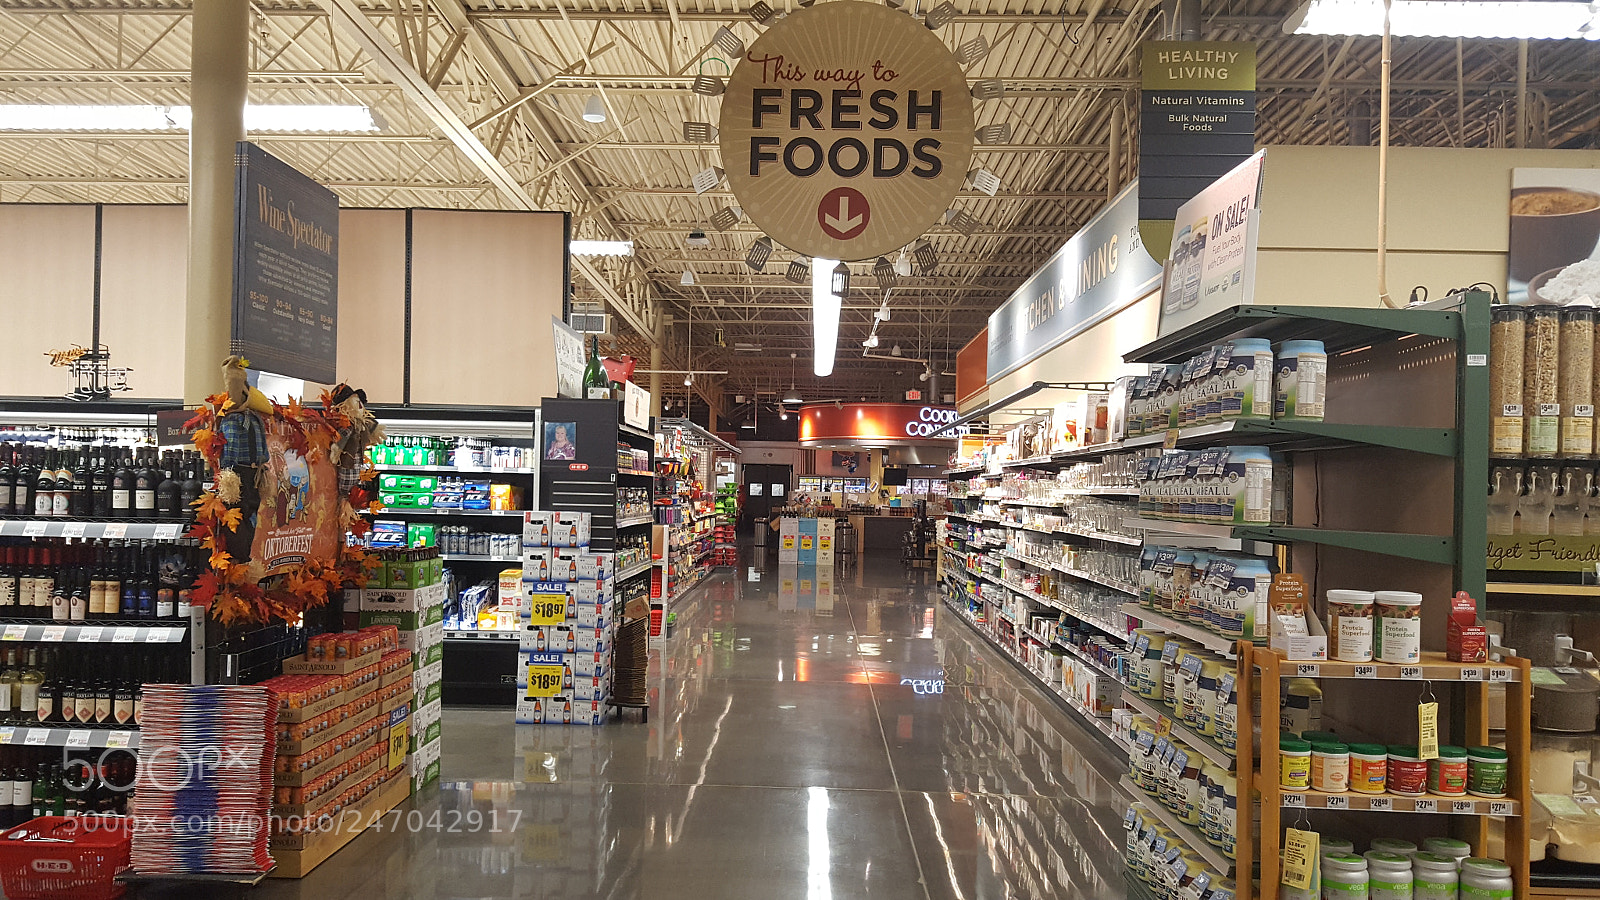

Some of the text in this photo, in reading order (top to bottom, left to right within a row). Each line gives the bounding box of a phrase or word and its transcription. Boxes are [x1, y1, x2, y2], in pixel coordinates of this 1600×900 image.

[1159, 50, 1239, 64] HEALTHY
[747, 51, 899, 96] This way to
[1168, 67, 1228, 80] LIVING
[1152, 96, 1245, 106] Natural Vitamins
[752, 88, 943, 131] FRESH
[1168, 114, 1227, 123] Bulk Natural
[1183, 123, 1212, 131] Foods
[749, 136, 943, 180] FOODS
[257, 183, 333, 255] Wine Spectator
[1211, 194, 1250, 240] ON SALE!
[1223, 380, 1238, 390] EAL
[1140, 486, 1152, 496] EAL
[1180, 486, 1194, 496] EAL
[372, 532, 405, 542] ICE
[264, 533, 314, 561] OKTOBERFEST
[536, 583, 563, 591] SALE!
[1222, 600, 1239, 610] EAL
[533, 654, 560, 662] SALE!
[392, 706, 406, 722] SALE!
[1349, 883, 1365, 891] vega
